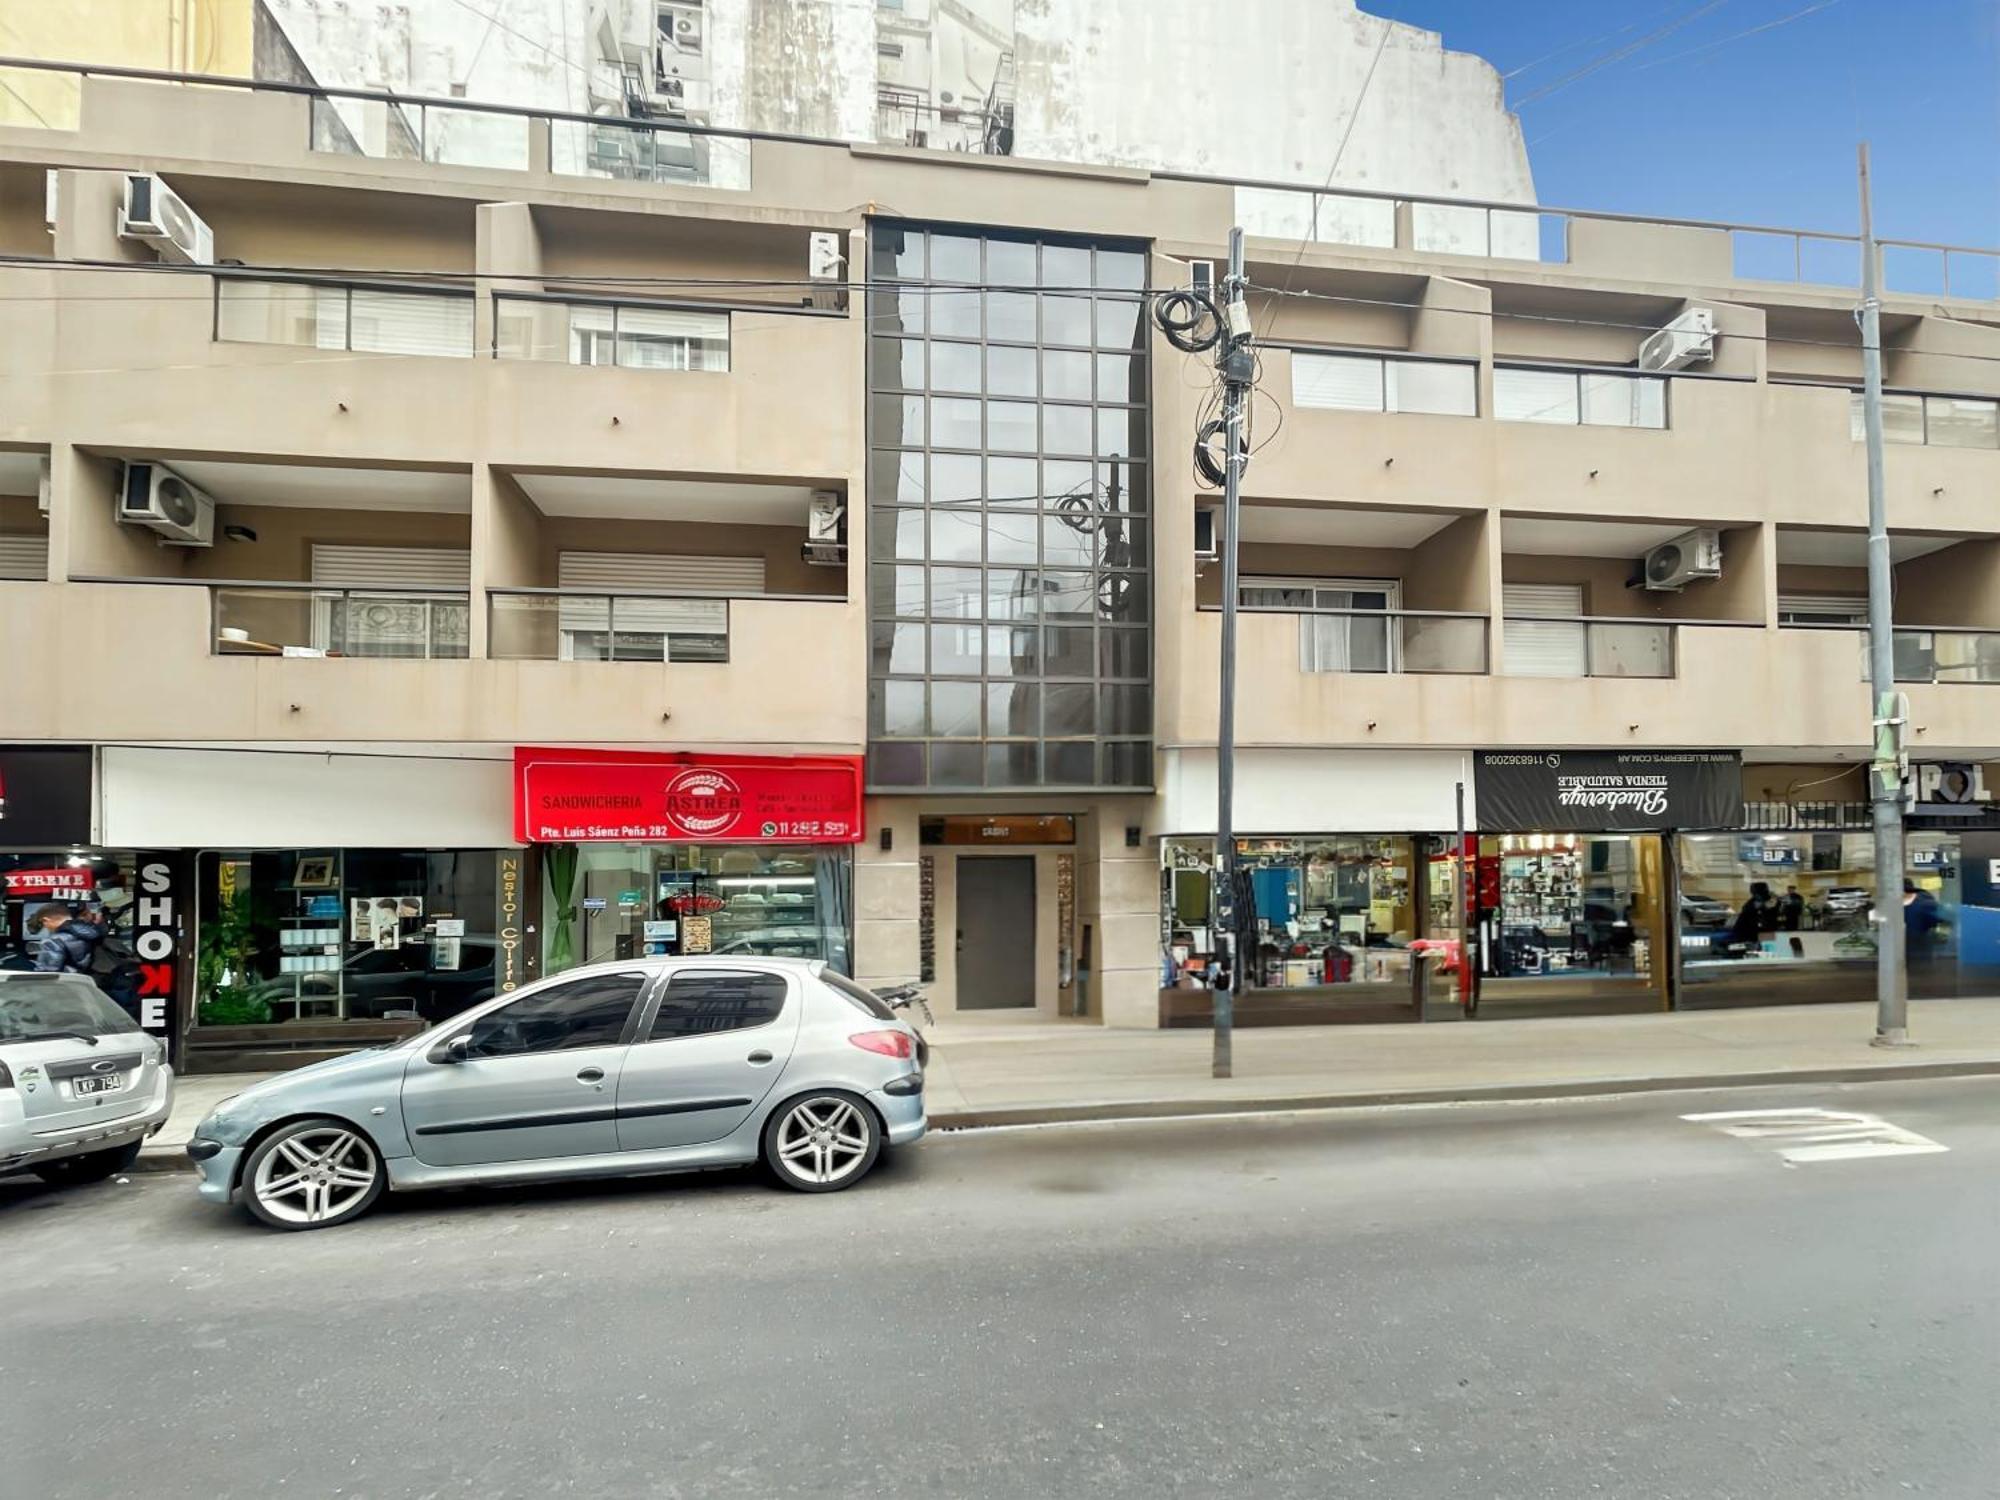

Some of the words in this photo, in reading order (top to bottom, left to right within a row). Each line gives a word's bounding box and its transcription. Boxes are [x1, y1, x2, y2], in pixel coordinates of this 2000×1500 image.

[1558, 775, 1623, 786] SALUDABLE
[1624, 775, 1667, 786] TIENDA
[667, 795, 740, 812] ASTREA
[1558, 785, 1668, 815] Blueberrys
[541, 826, 562, 838] Pte.
[564, 826, 586, 838] Luis
[588, 825, 618, 837] Sáenz
[622, 825, 646, 836] Peña
[649, 825, 667, 836] 282
[1763, 850, 1801, 862] ELIPL
[1914, 851, 1949, 864] ELIPL
[503, 859, 517, 923] Nestor
[136, 863, 173, 1028] SHOKE
[77, 1080, 95, 1094] LKP
